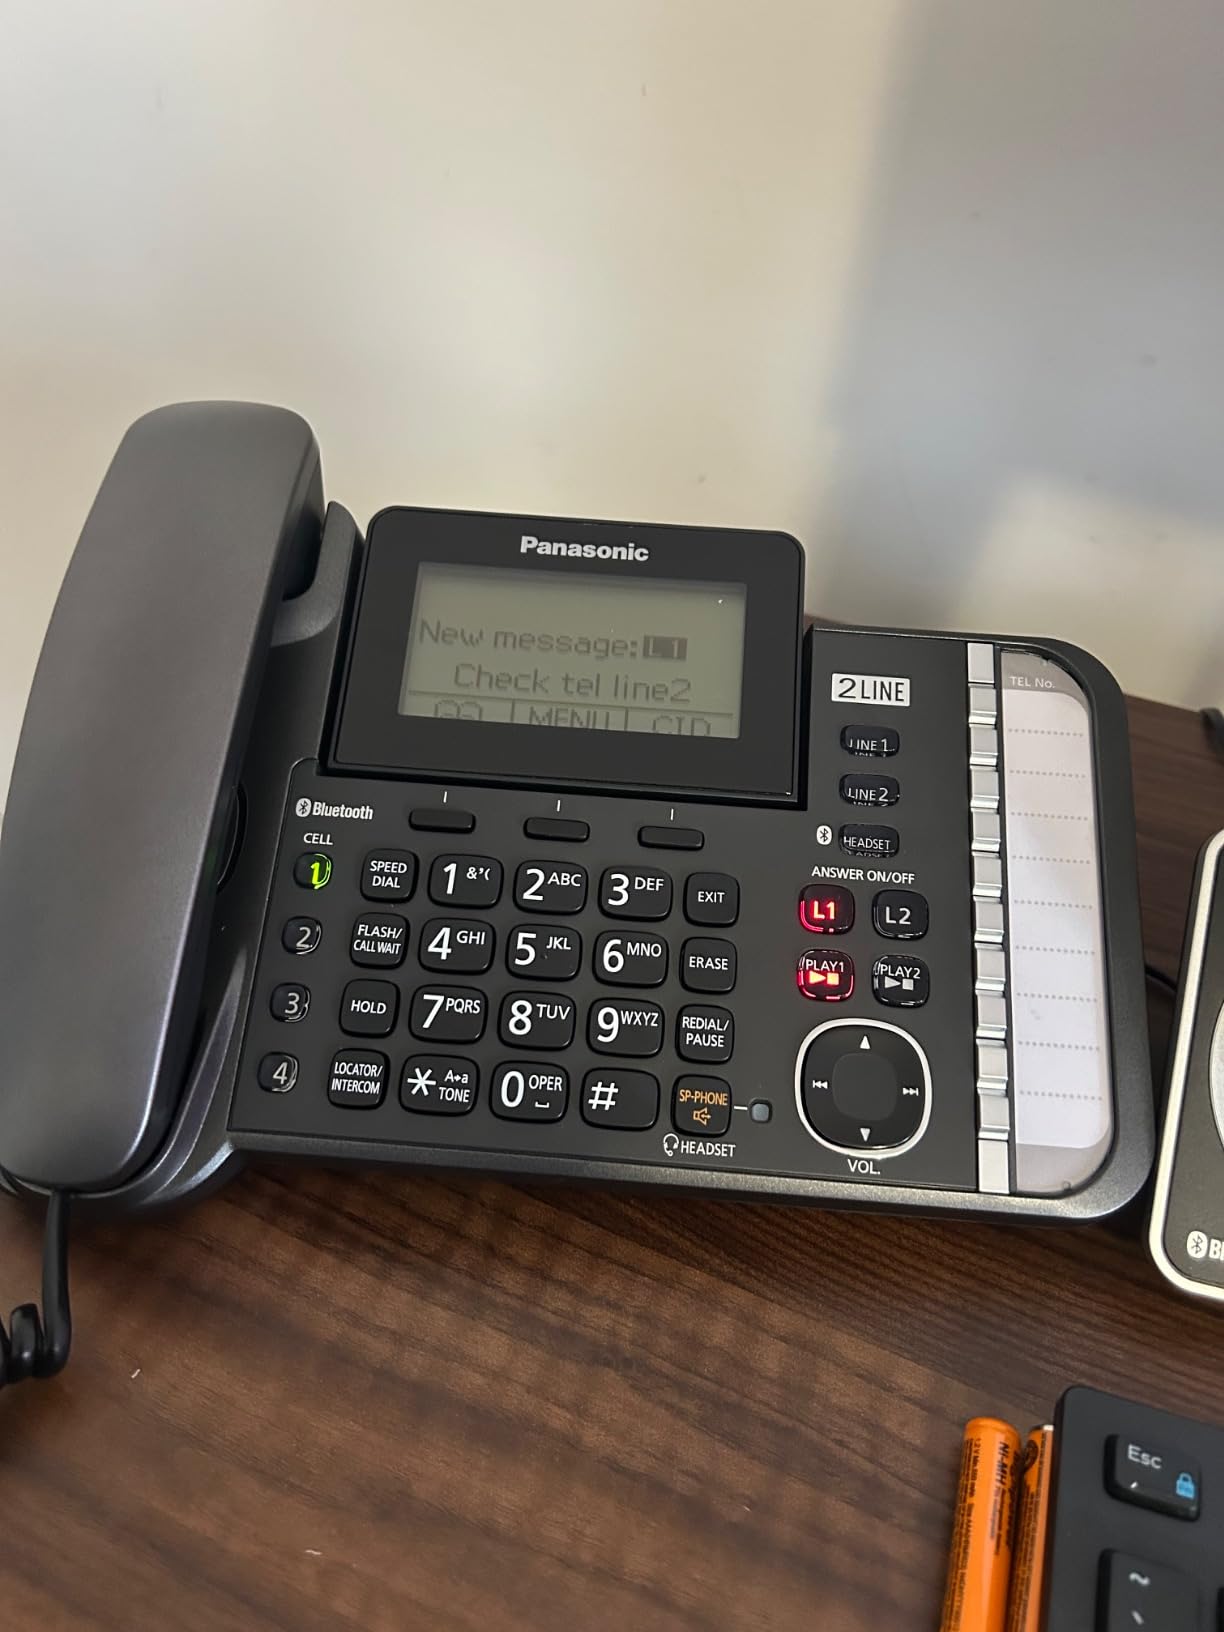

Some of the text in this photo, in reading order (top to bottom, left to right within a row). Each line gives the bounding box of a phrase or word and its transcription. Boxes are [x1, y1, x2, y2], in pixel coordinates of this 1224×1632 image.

[521, 536, 648, 561] Panasonic
[419, 619, 484, 648] New
[493, 631, 638, 660] message:
[454, 663, 692, 702] Check tel line2
[1009, 674, 1056, 690] TEL No.
[847, 786, 890, 802] LINE 2
[313, 802, 373, 819] Bluetooth
[304, 833, 333, 845] CELL
[843, 836, 892, 851] HEADSET
[309, 861, 321, 886] 1
[370, 861, 407, 873] SPEED
[812, 866, 914, 884] ANSWER ON/OFF
[372, 876, 400, 888] DIAL
[444, 863, 456, 894] 1
[523, 869, 581, 900] 2 ABC
[608, 874, 664, 905] 3 DEF
[698, 891, 725, 903] EXIT
[812, 900, 837, 920] L1
[886, 907, 910, 924] L2
[296, 927, 311, 948] 2
[358, 925, 402, 938] FLASH/
[354, 940, 401, 954] CALL WAIT
[428, 928, 485, 960] 4 GHI
[515, 933, 571, 965] 5 JKL
[603, 939, 661, 972] 6 MNO
[689, 956, 728, 970] ERASE
[804, 956, 845, 973] PLAY1
[879, 963, 921, 981] PLAY2
[285, 992, 299, 1014] 3
[351, 1000, 386, 1014] HOLD
[423, 995, 480, 1028] 7 PQRS
[509, 1000, 570, 1035] 8 TUV
[598, 1007, 658, 1042] 9 WXYZ
[682, 1017, 729, 1034] REDIAL/
[686, 1033, 724, 1047] PAUSE
[273, 1061, 288, 1085] 4
[334, 1062, 382, 1079] LOCATOR/
[332, 1076, 380, 1094] INTERCOM
[501, 1071, 562, 1107] 0 OPER
[439, 1087, 470, 1102] TONE
[588, 1082, 618, 1110] #
[680, 1090, 727, 1105] SP-PHONE
[681, 1141, 736, 1157] HEADSET
[848, 1157, 883, 1174] VOL.
[1127, 1444, 1163, 1470] Esc
